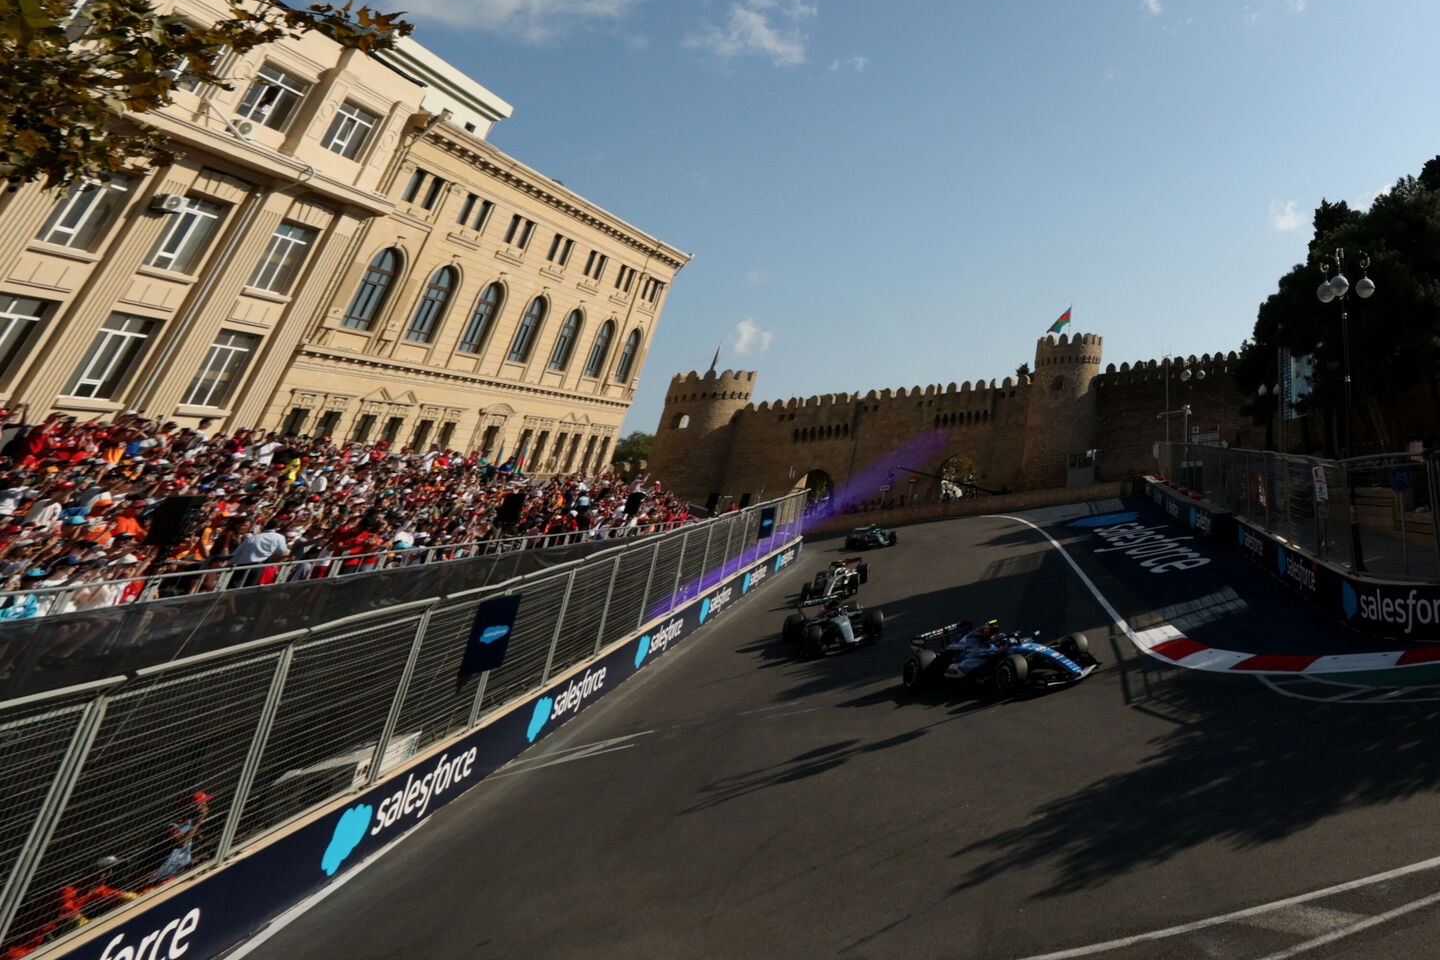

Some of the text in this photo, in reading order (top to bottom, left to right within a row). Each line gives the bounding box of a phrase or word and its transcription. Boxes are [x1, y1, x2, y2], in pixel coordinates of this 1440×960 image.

[1092, 522, 1212, 574] salesforce
[1286, 553, 1316, 592] salesforce
[648, 618, 684, 654] salesforce
[550, 666, 608, 720] salesforce
[370, 746, 478, 837] salesforce
[99, 907, 201, 960] rce
